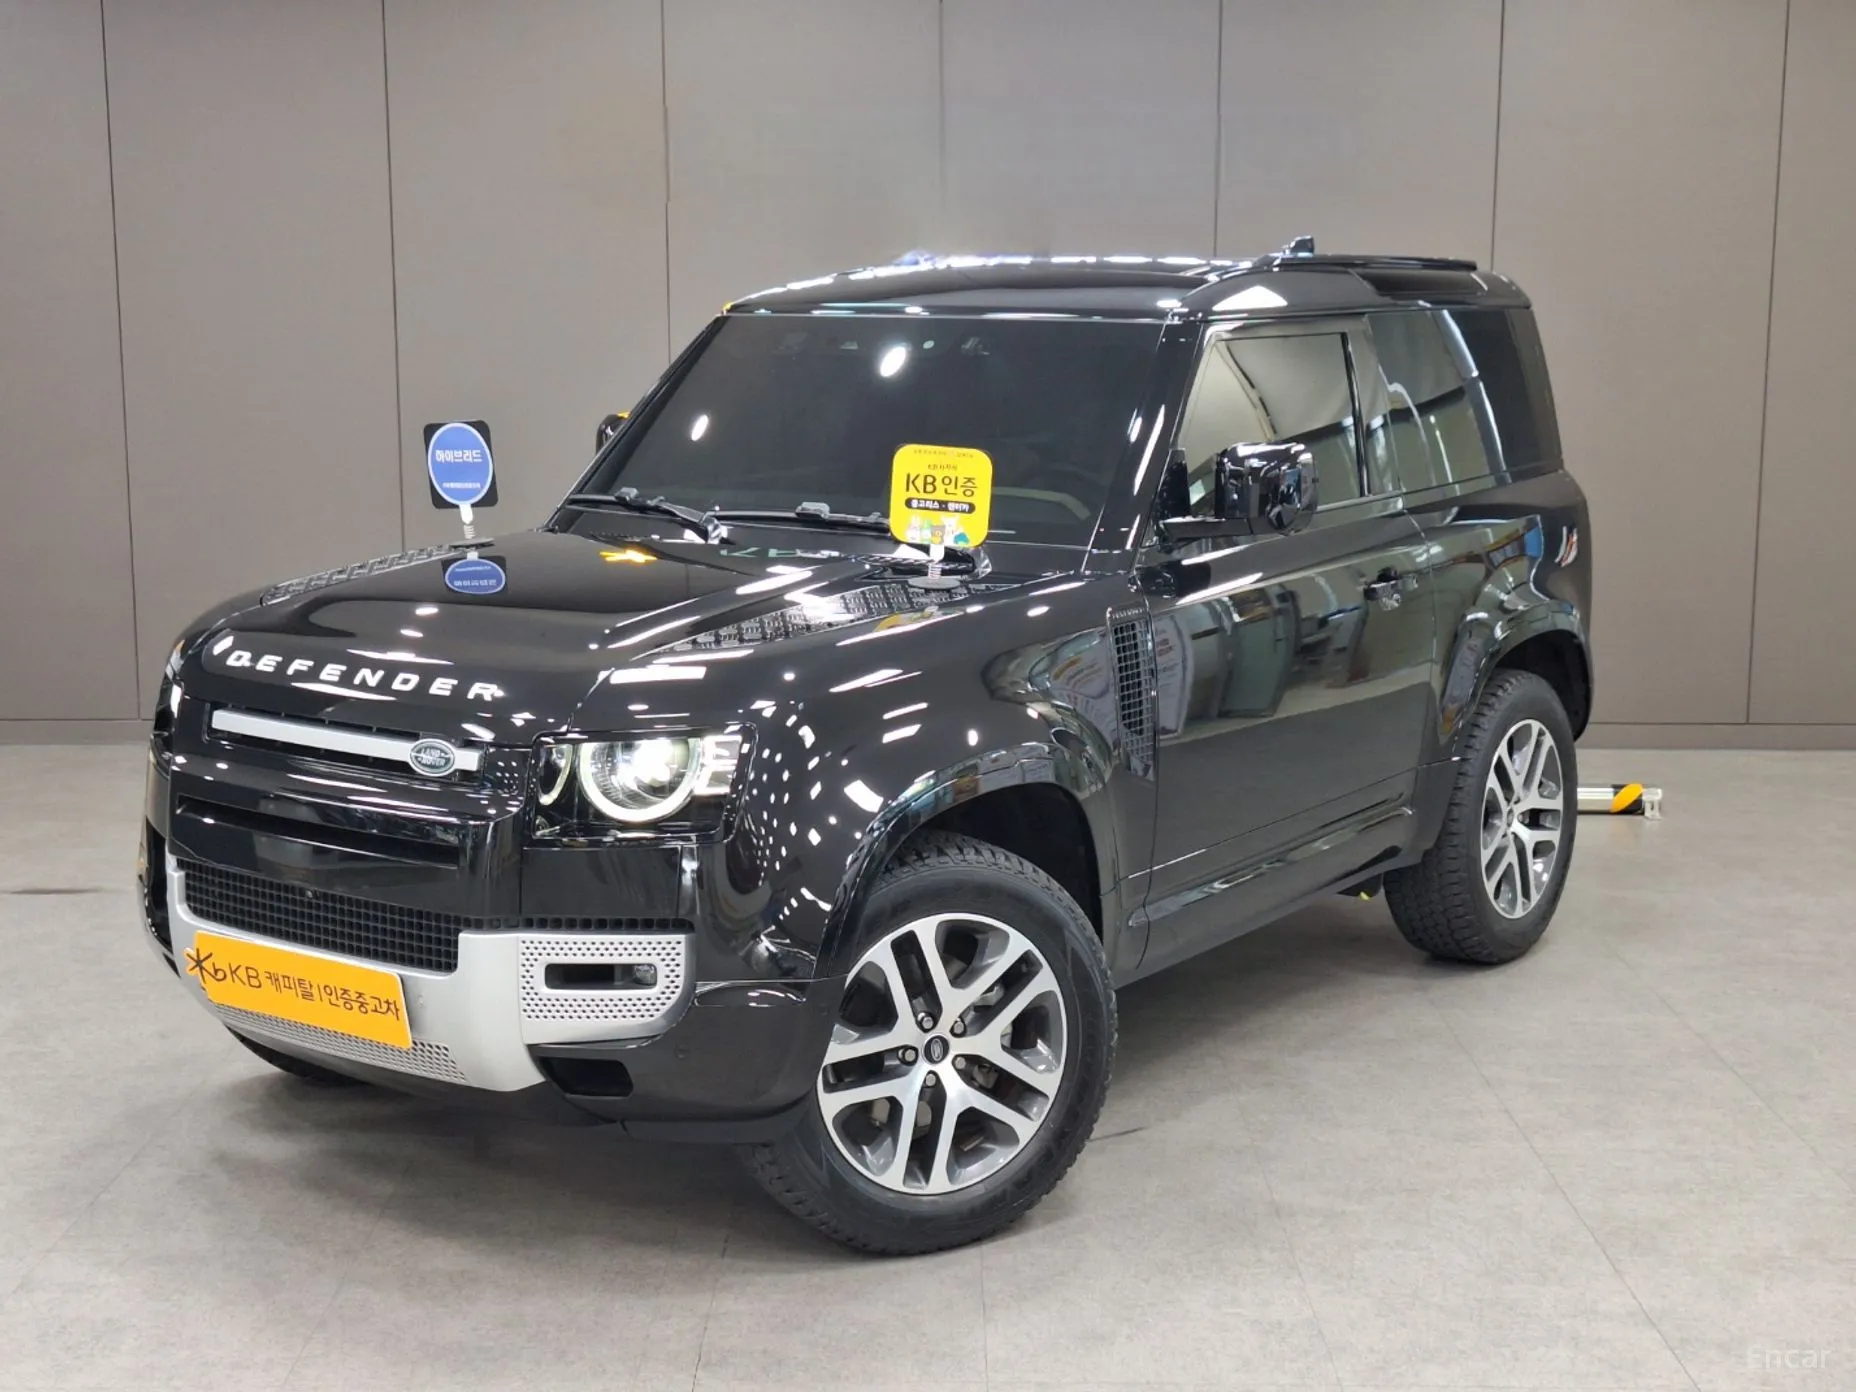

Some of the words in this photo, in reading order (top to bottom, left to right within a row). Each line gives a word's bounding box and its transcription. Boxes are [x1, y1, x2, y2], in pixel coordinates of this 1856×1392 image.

[435, 449, 482, 463] 하이브리드
[906, 472, 937, 494] KB
[941, 475, 978, 498] 인증
[226, 650, 500, 702] DEFENDER
